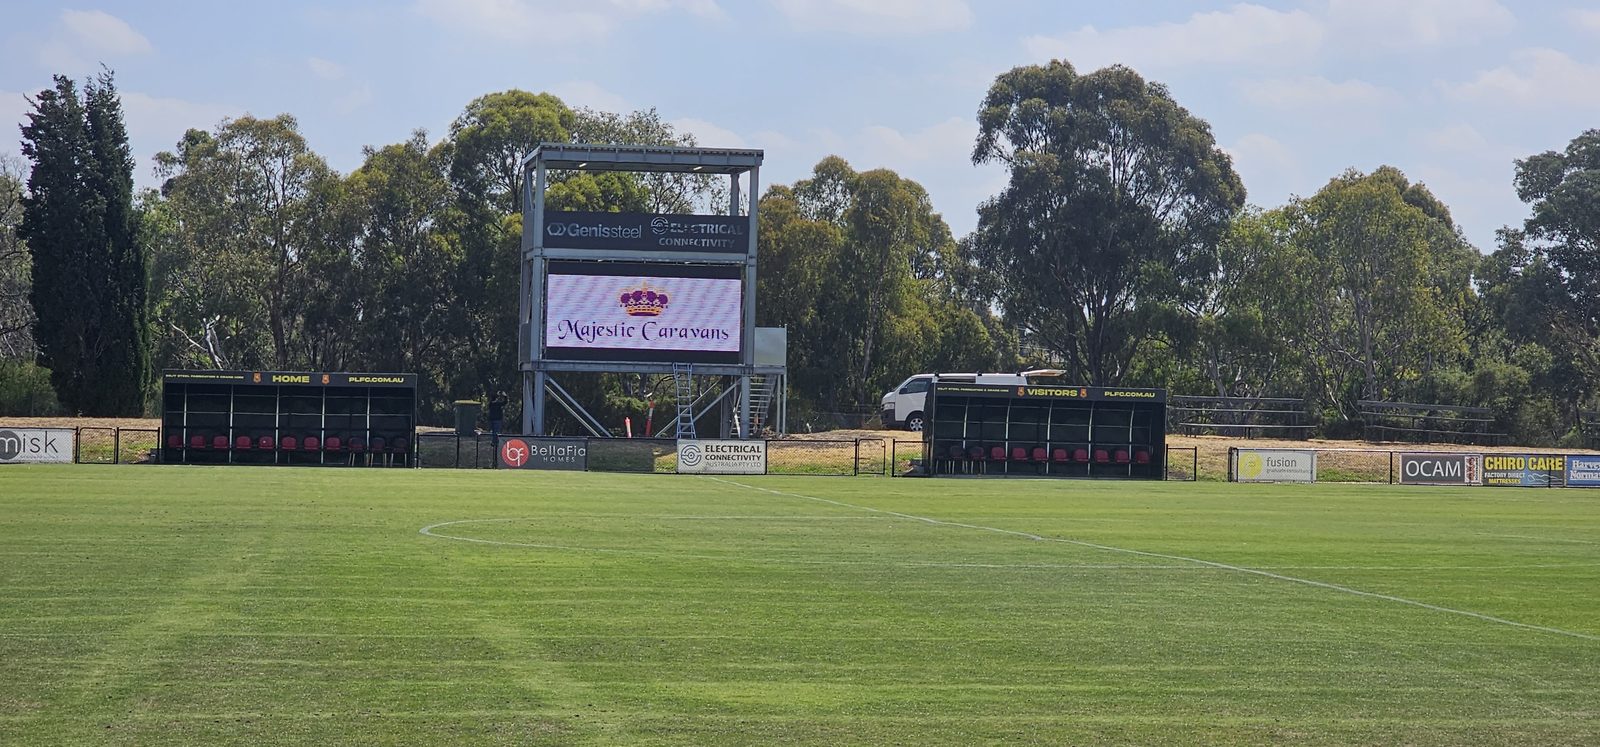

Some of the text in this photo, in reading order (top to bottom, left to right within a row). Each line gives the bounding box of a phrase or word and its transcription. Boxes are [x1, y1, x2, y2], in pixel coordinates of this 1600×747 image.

[567, 223, 642, 239] Genissteel
[670, 222, 743, 235] ELECTRICAL
[658, 238, 735, 248] CONNECTIVITY
[557, 319, 729, 343] Majestic Caravans
[272, 375, 310, 383] HOME
[1027, 388, 1078, 396] VISITORS
[0, 430, 58, 453] misk
[531, 445, 586, 456] BellaFia
[705, 445, 762, 453] ELECTRICAL
[1266, 457, 1297, 467] fusion
[1484, 456, 1525, 470] CHIRO
[1527, 457, 1563, 471] CARE
[1405, 460, 1461, 477] OCAM
